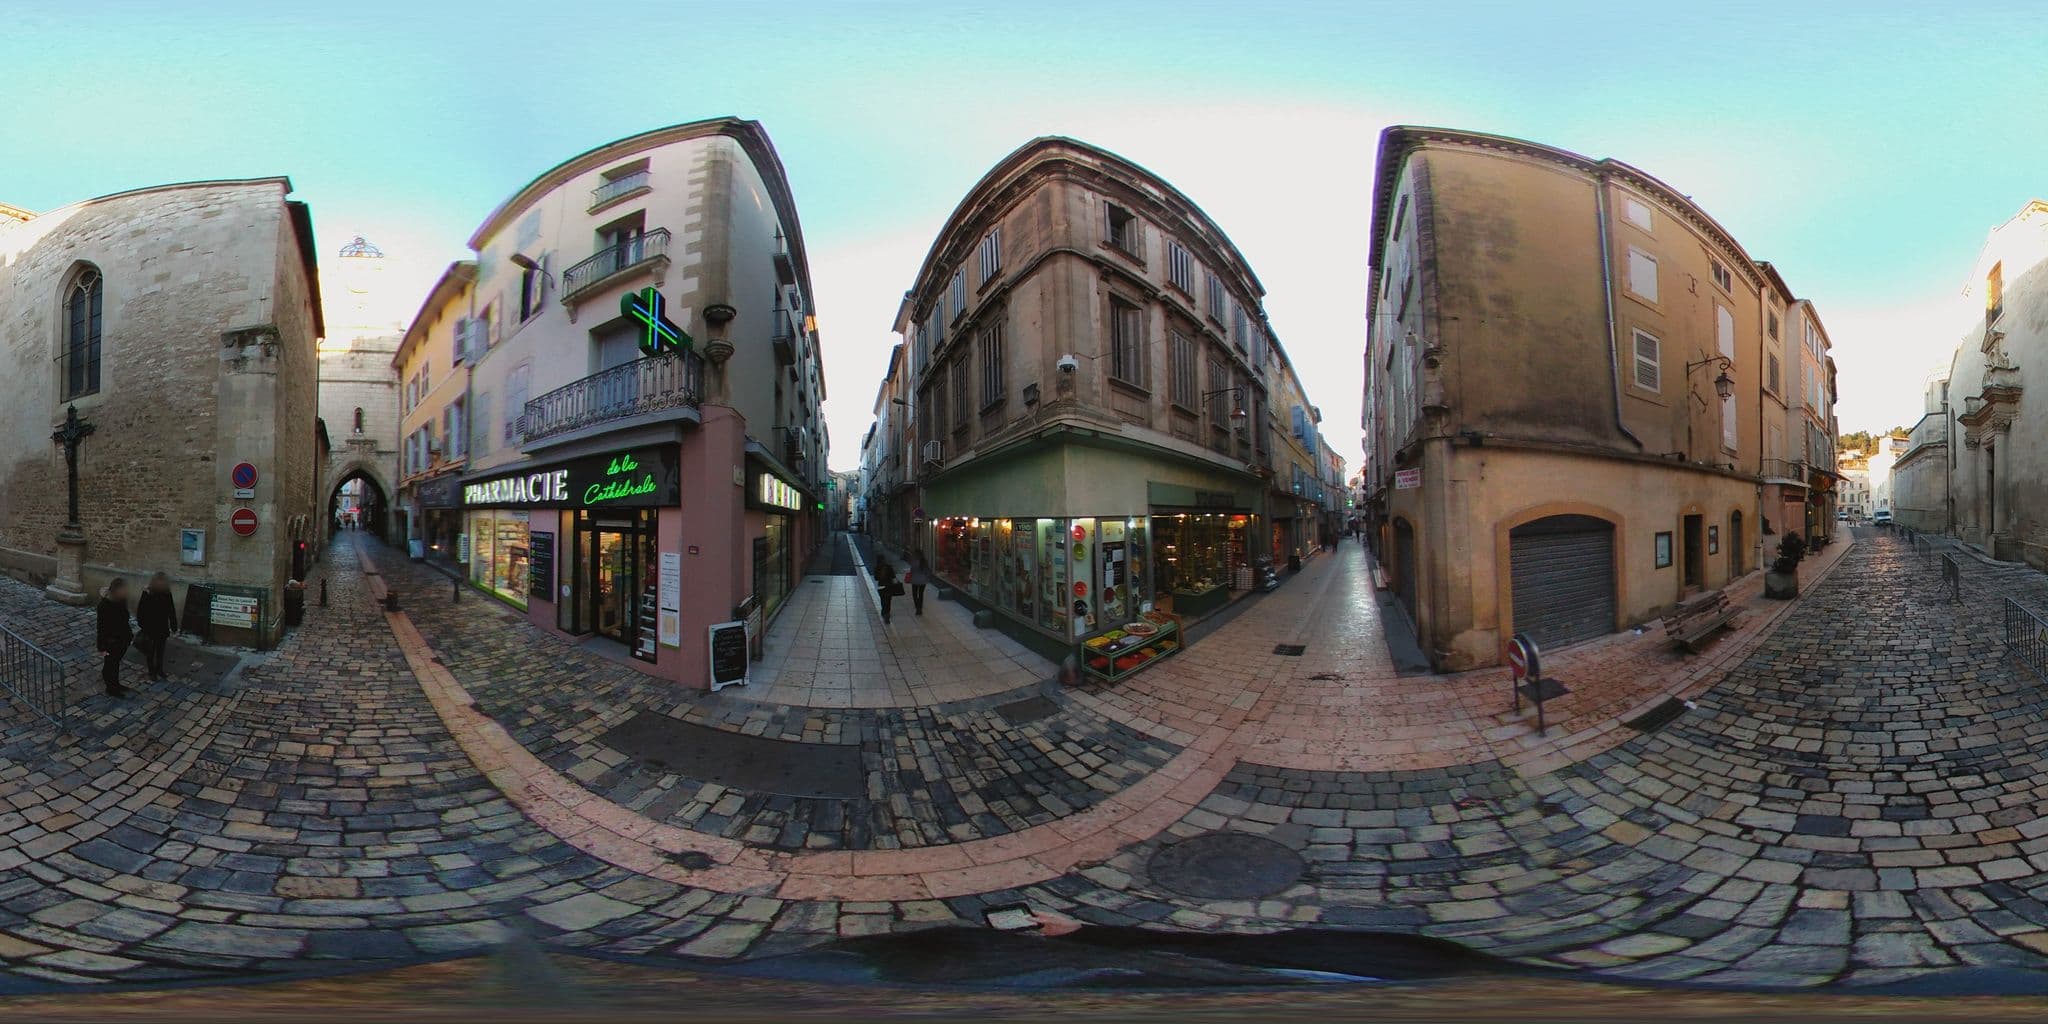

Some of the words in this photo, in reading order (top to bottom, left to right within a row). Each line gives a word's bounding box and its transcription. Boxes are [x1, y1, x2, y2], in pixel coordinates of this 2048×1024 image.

[607, 458, 620, 475] de
[622, 454, 639, 472] la
[464, 469, 569, 505] PHARMACIE
[584, 474, 657, 505] Cathédrale
